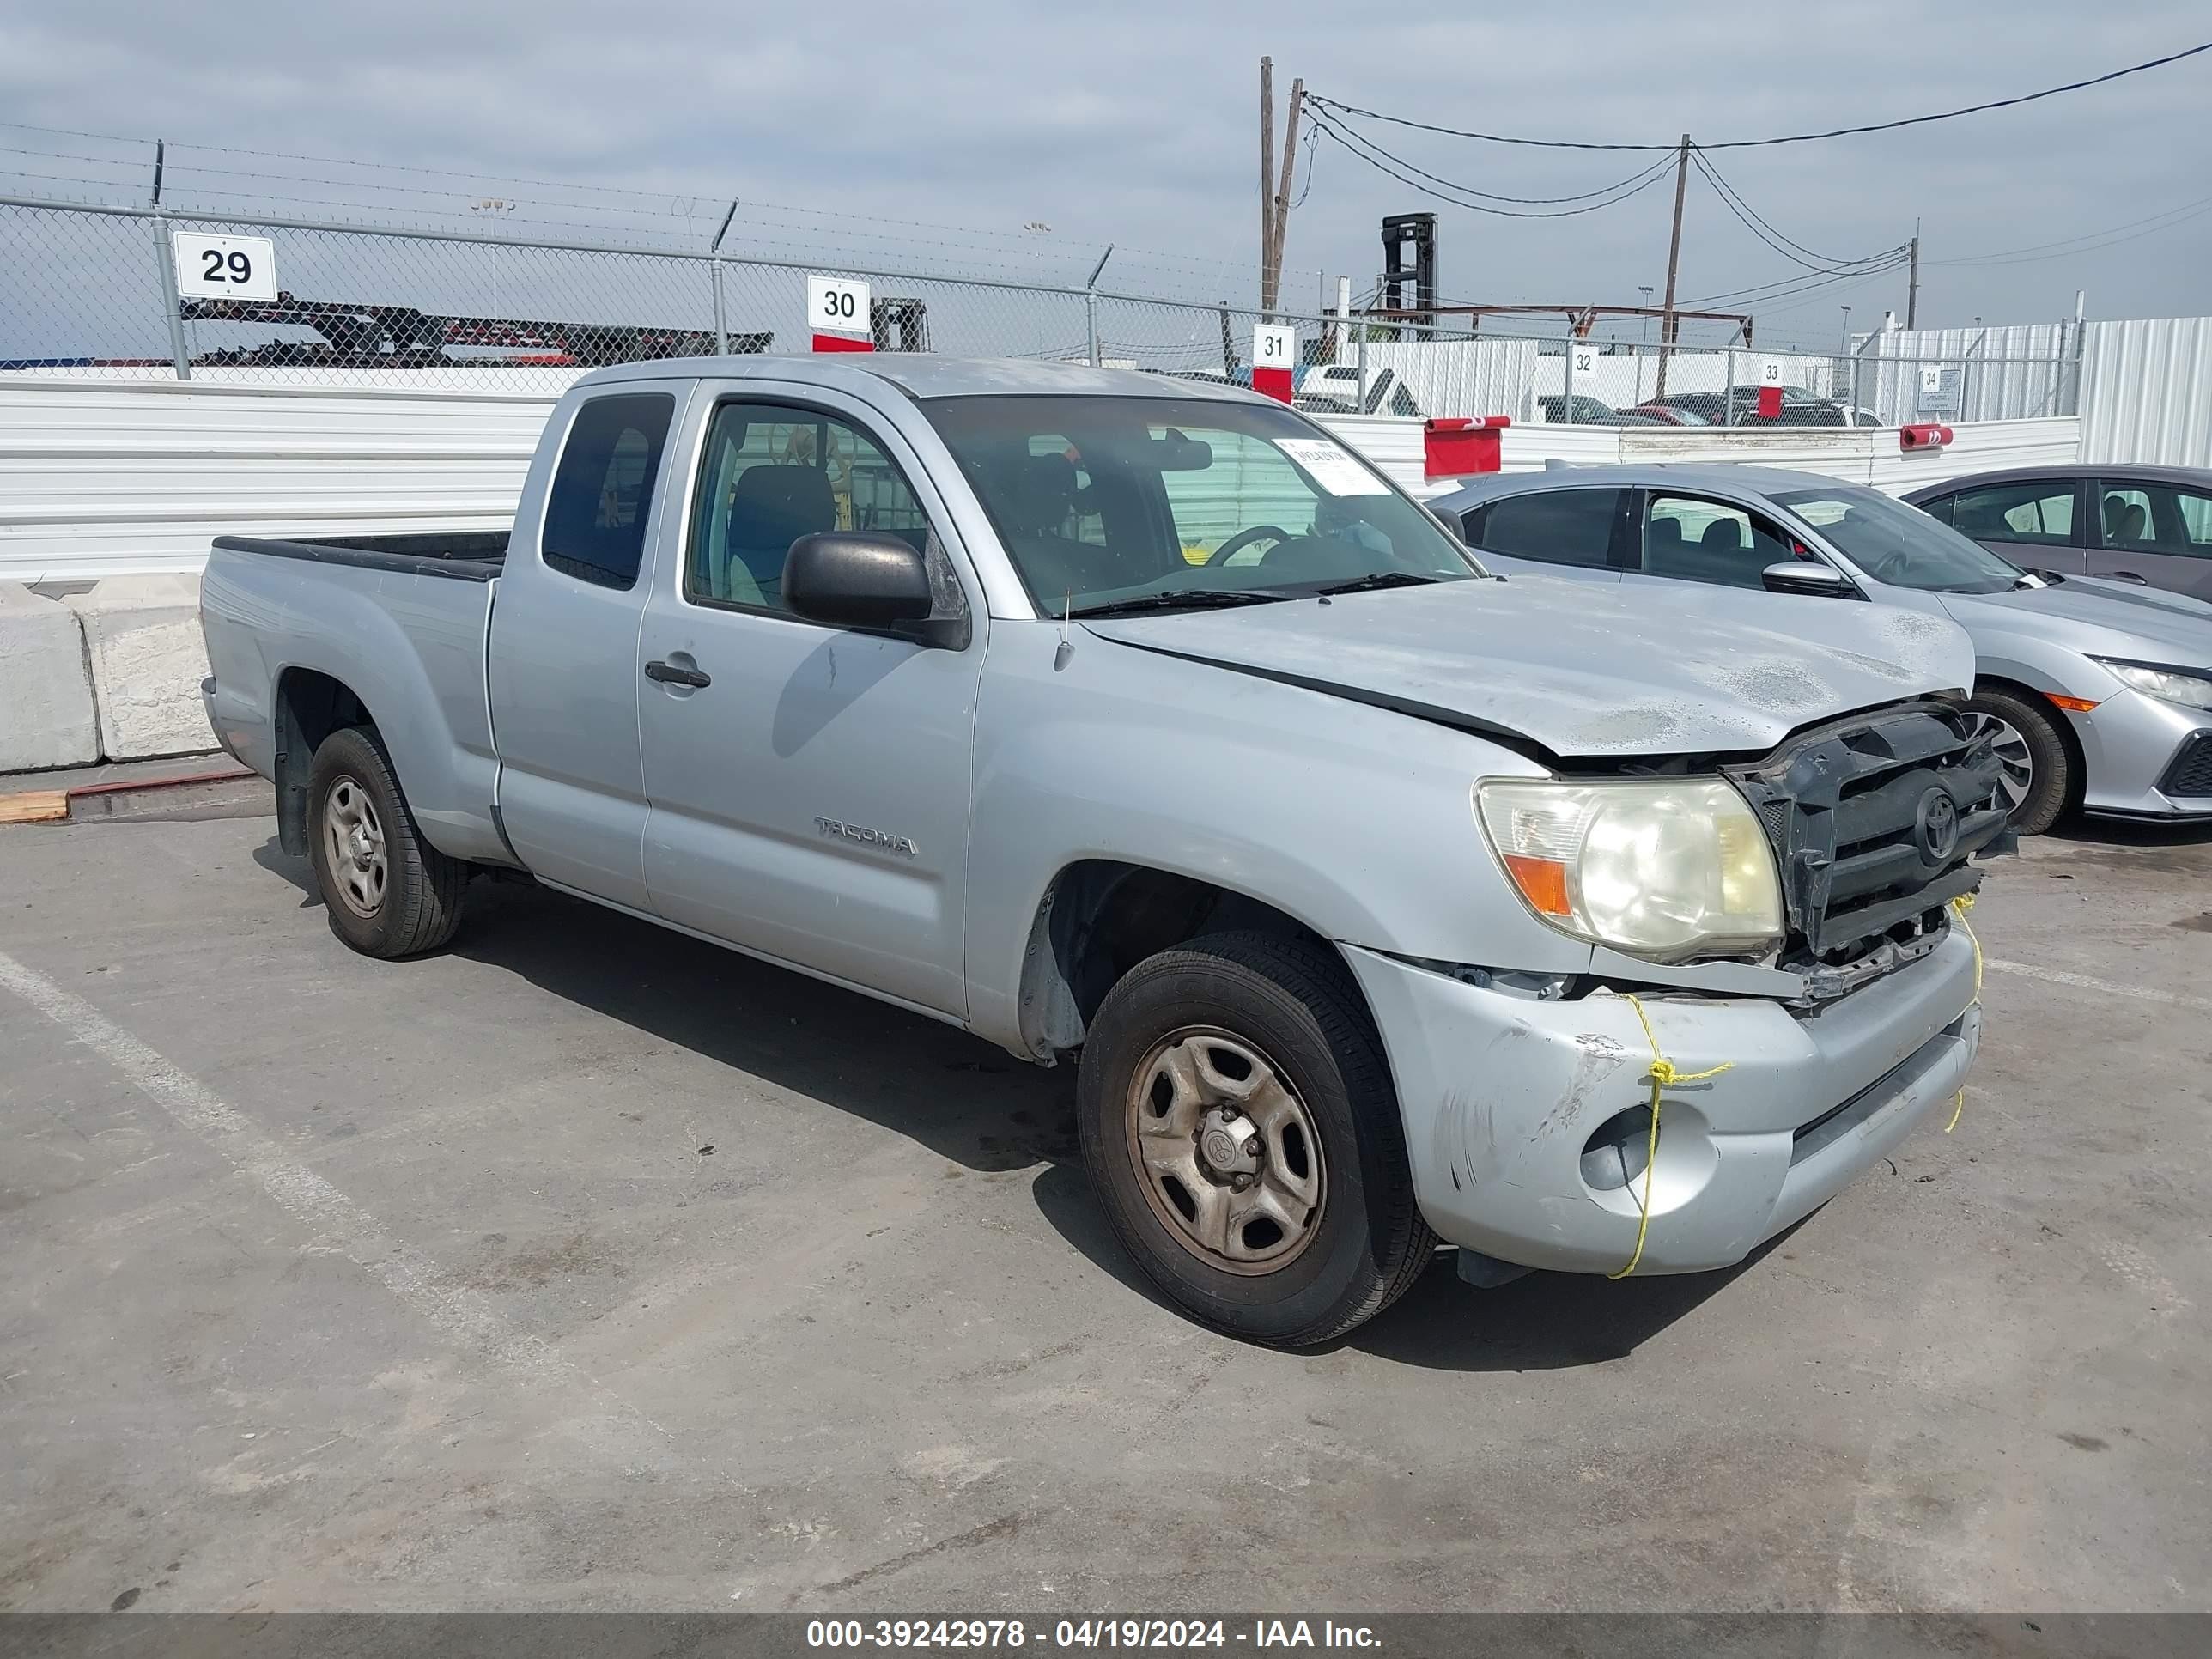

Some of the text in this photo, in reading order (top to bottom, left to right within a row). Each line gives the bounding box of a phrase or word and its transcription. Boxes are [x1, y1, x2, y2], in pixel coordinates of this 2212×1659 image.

[202, 250, 251, 283] 29
[824, 291, 854, 318] 30
[1265, 336, 1282, 356] 31
[1577, 354, 1590, 371] 32
[1766, 365, 1778, 380] 33
[1927, 372, 1936, 386] 34
[814, 815, 919, 854] TACOMA
